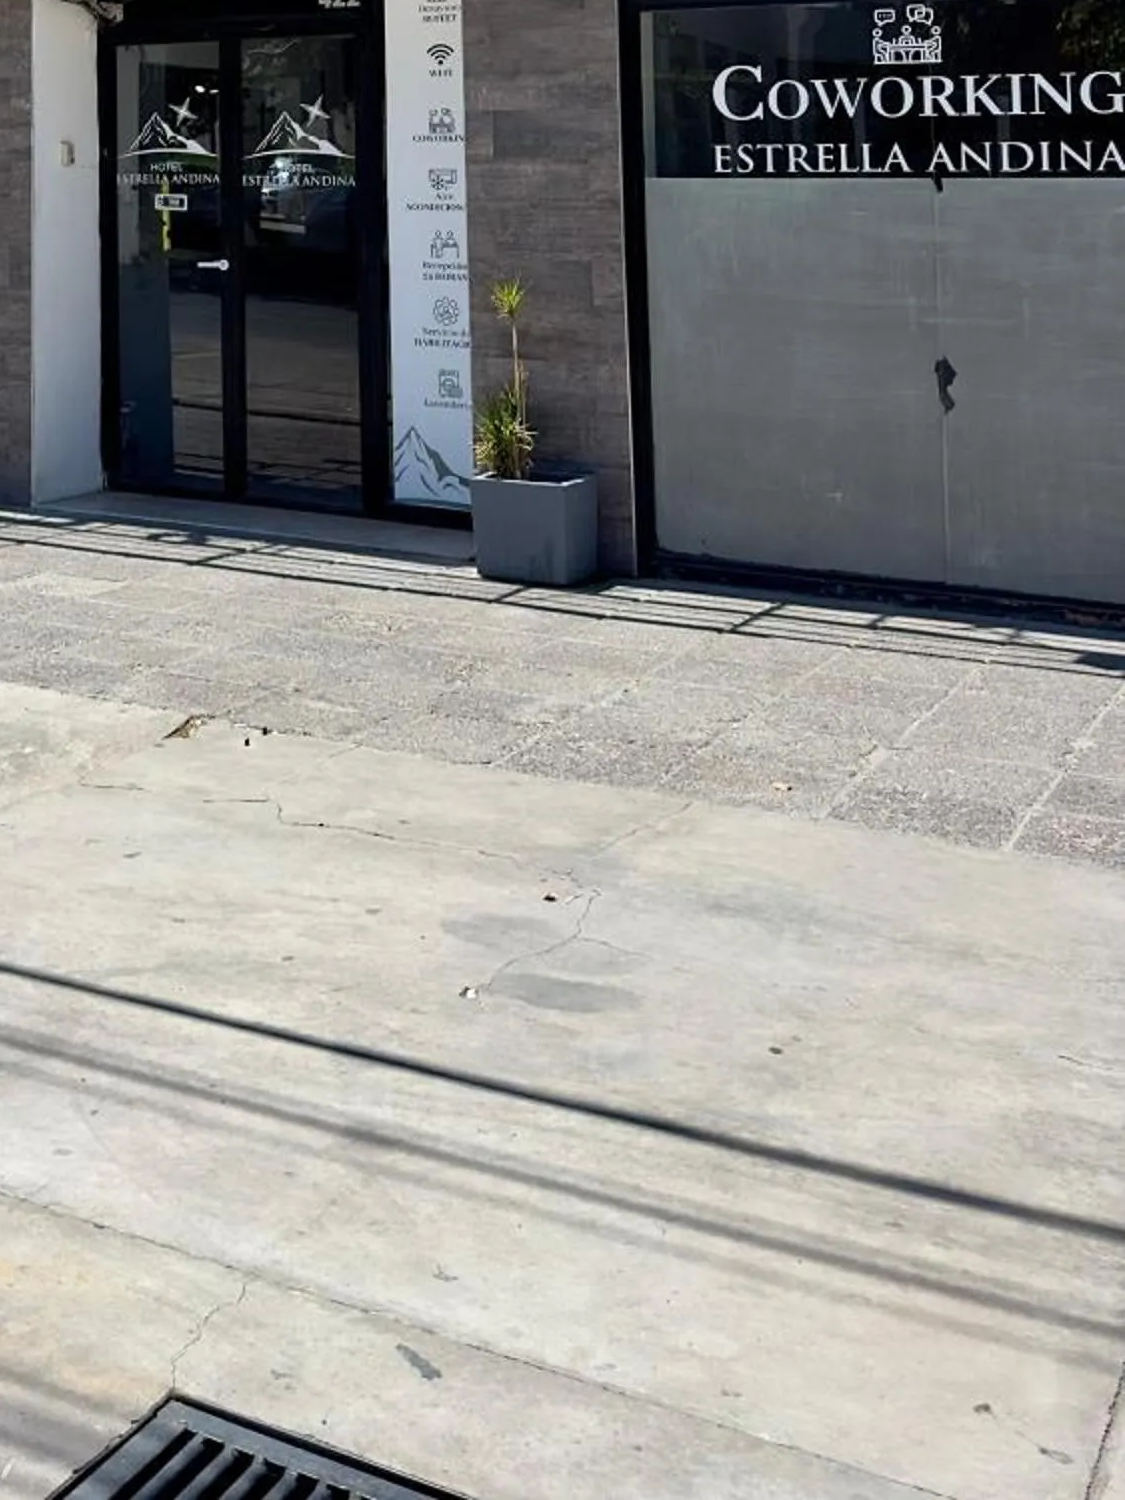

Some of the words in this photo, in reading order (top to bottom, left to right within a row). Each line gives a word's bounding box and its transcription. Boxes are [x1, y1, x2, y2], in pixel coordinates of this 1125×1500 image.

[711, 64, 1125, 122] COWORKING
[714, 142, 915, 174] ESTRELLA
[926, 140, 1125, 174] ANDINA
[150, 162, 184, 173] HOTEL
[170, 173, 220, 185] ANDINA
[302, 174, 356, 187] ANDINA
